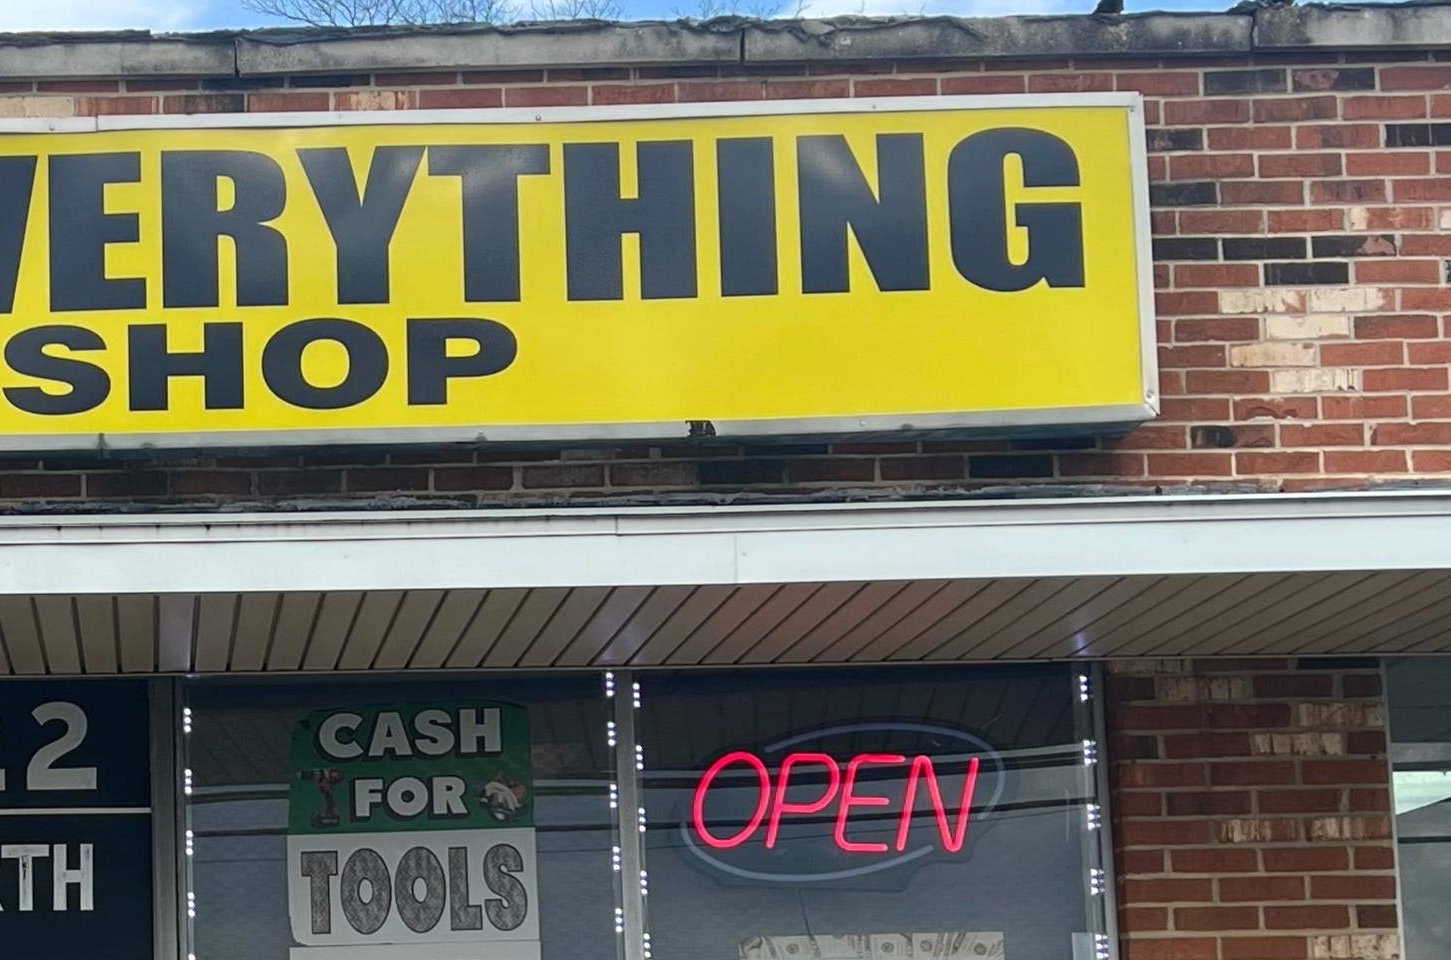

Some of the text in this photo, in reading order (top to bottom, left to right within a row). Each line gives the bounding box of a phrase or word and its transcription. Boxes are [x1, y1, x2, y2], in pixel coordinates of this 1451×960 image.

[2, 317, 518, 415] SHOP
[318, 706, 503, 762] CASH
[350, 775, 469, 822] FOR
[692, 750, 980, 853] OPEN
[300, 843, 529, 935] TOOLS
